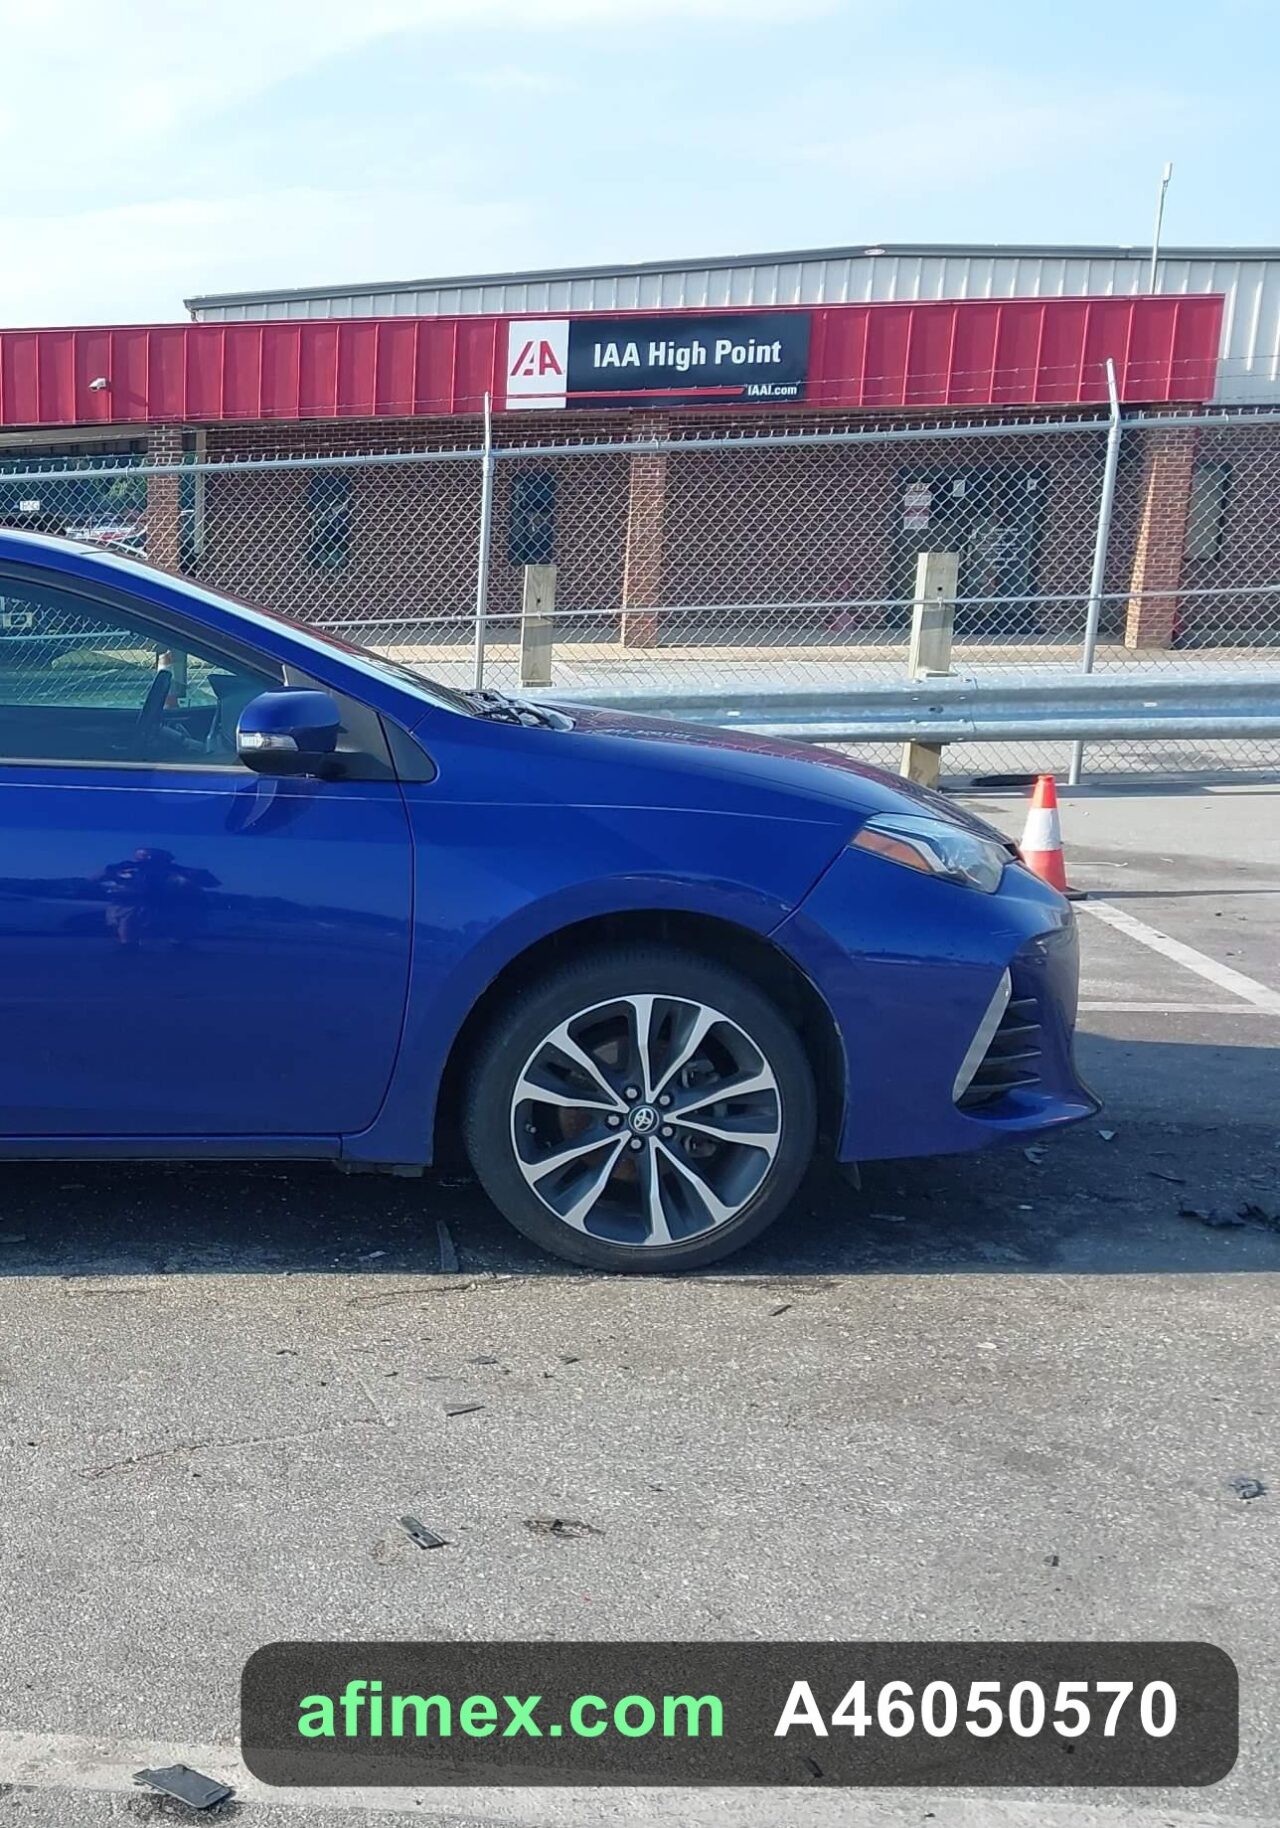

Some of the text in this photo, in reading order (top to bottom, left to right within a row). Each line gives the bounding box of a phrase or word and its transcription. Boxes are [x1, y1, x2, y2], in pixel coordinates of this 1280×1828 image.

[593, 339, 782, 372] IAA High Point
[747, 384, 798, 396] IAAI.com
